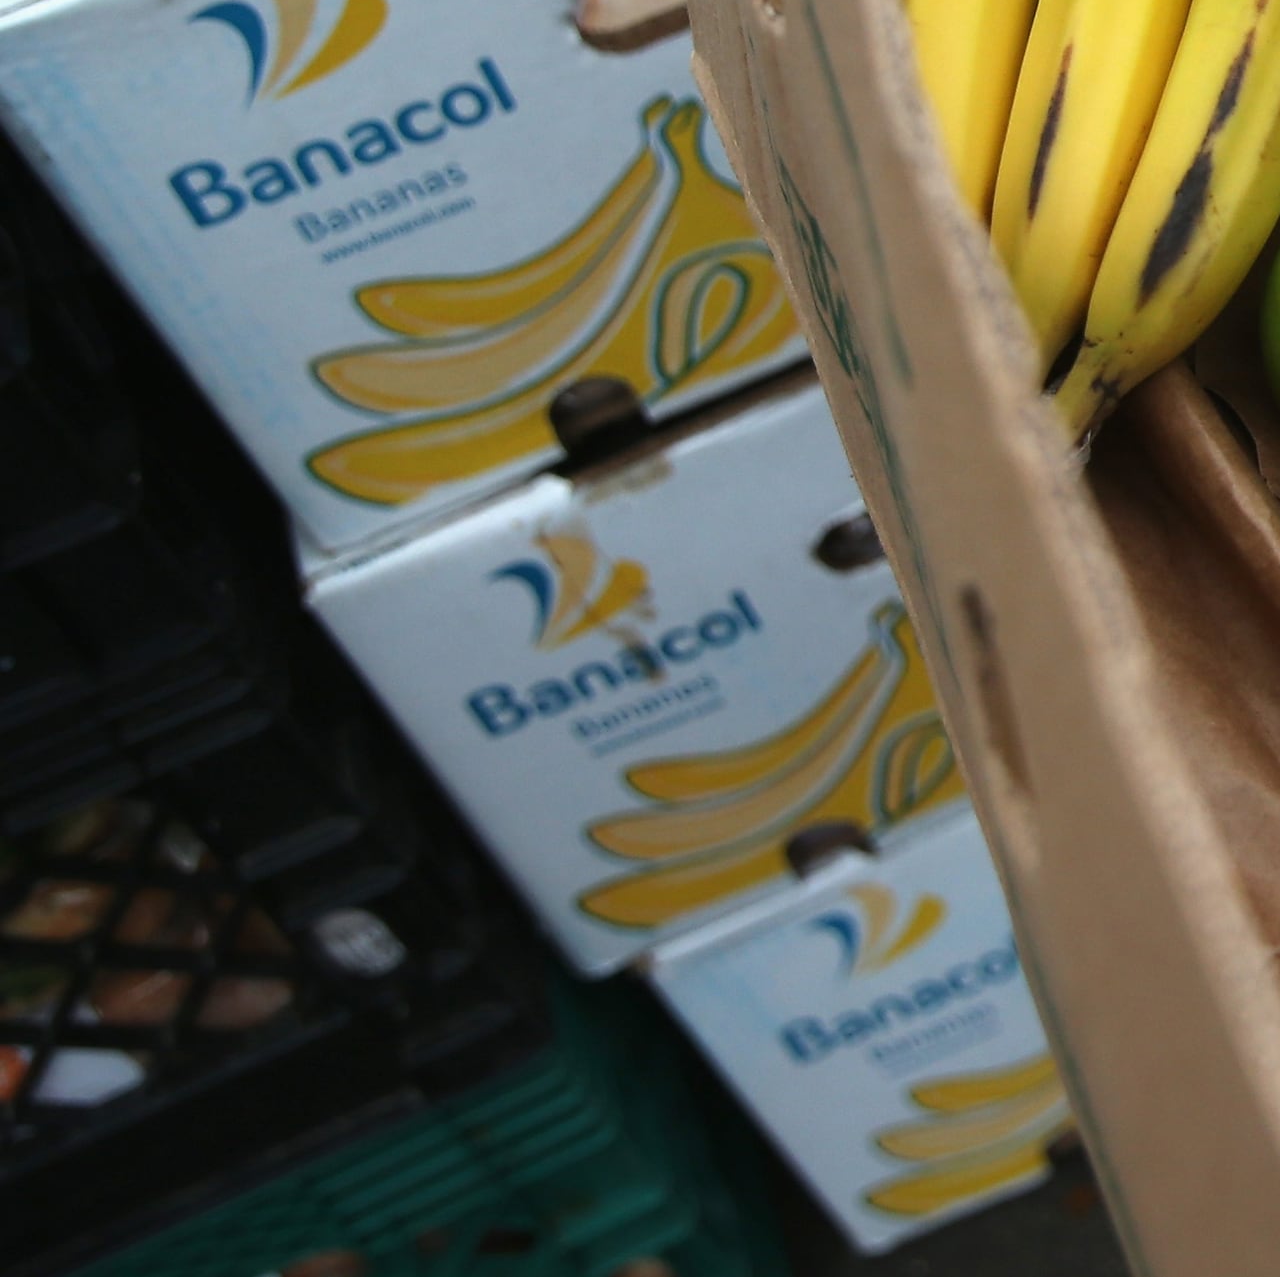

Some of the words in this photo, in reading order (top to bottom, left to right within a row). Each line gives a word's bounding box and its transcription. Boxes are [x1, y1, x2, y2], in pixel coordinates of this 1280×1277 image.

[169, 57, 517, 228] Banacol
[297, 162, 468, 244] Bananas
[468, 588, 763, 738] Banacol
[780, 938, 1019, 1066] Banaco
